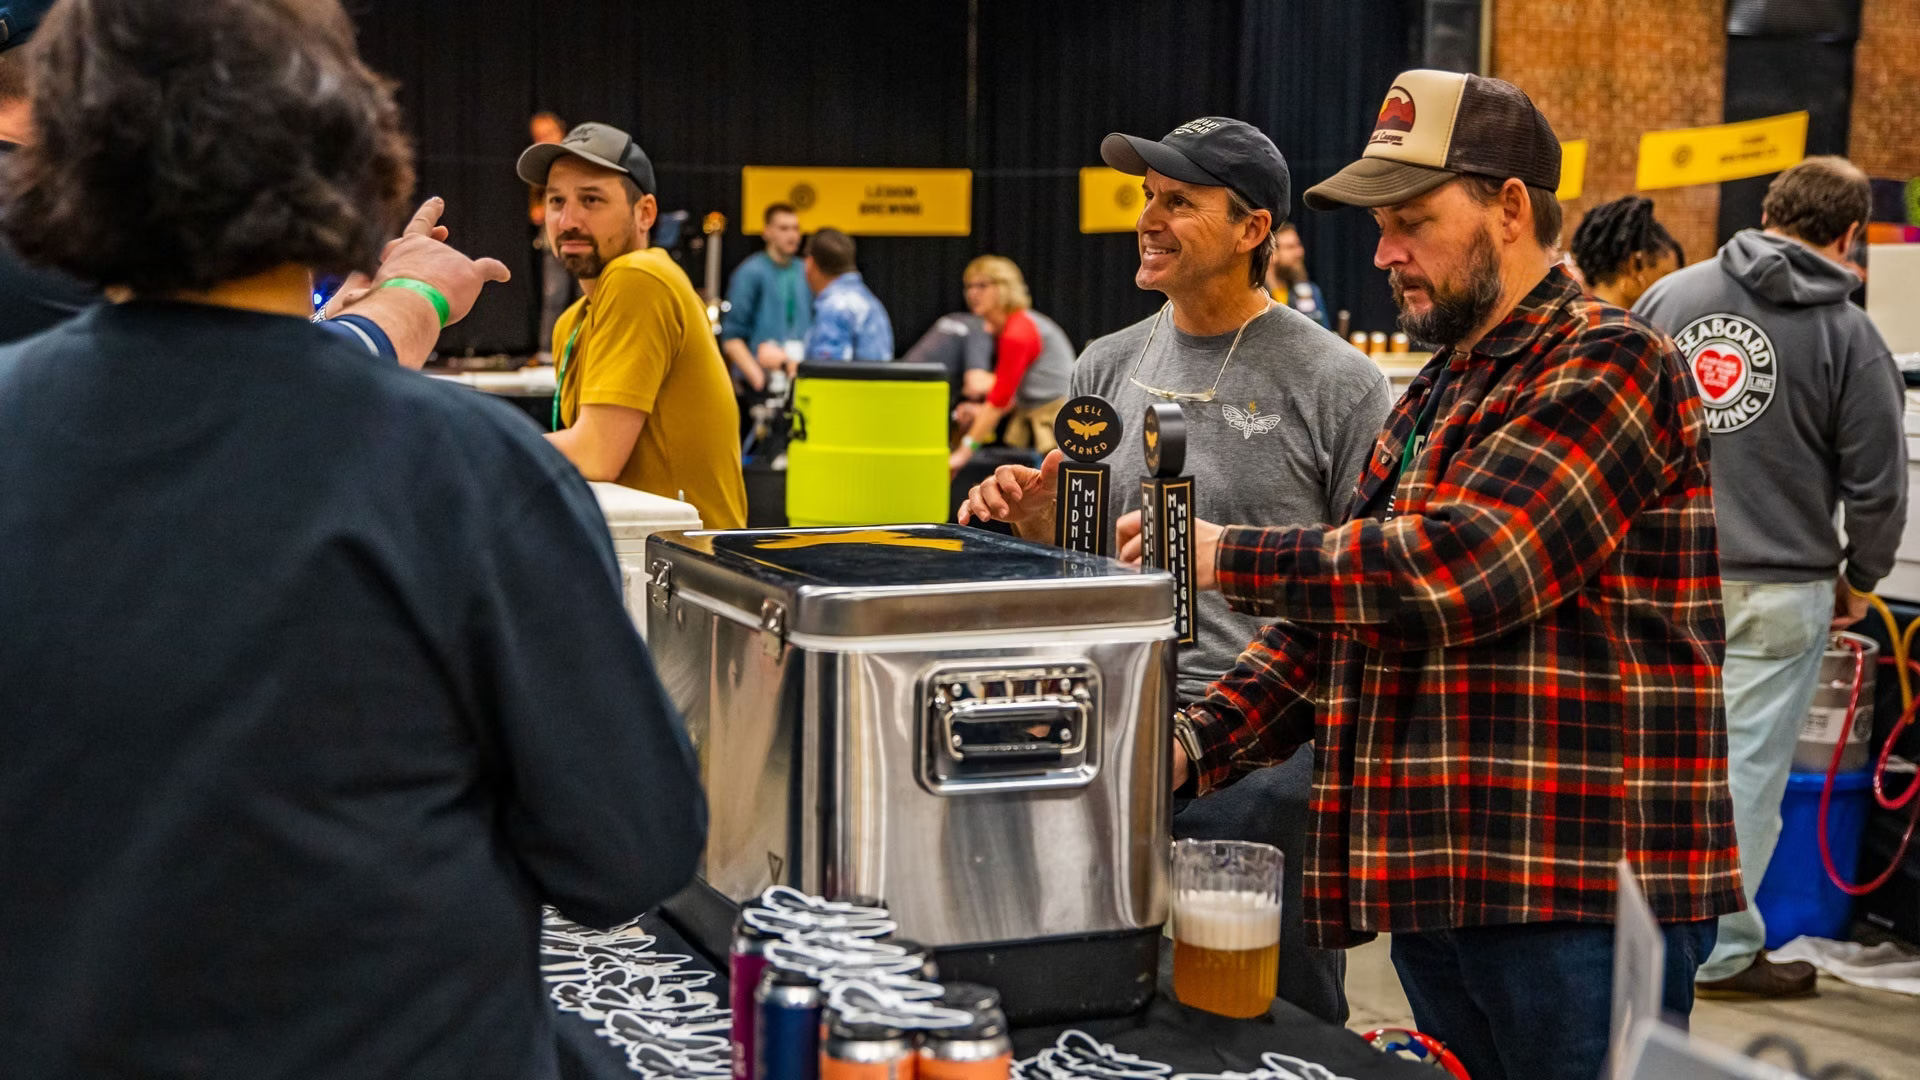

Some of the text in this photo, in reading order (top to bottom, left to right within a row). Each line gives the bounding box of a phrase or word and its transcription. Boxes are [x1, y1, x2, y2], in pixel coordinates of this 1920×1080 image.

[1677, 318, 1771, 367] SEABOARD
[1073, 404, 1103, 417] WELL
[1704, 394, 1762, 428] WING
[1063, 438, 1108, 455] EARNED
[1071, 479, 1082, 553] MIDNI
[1177, 503, 1188, 634] MULLIGAN
